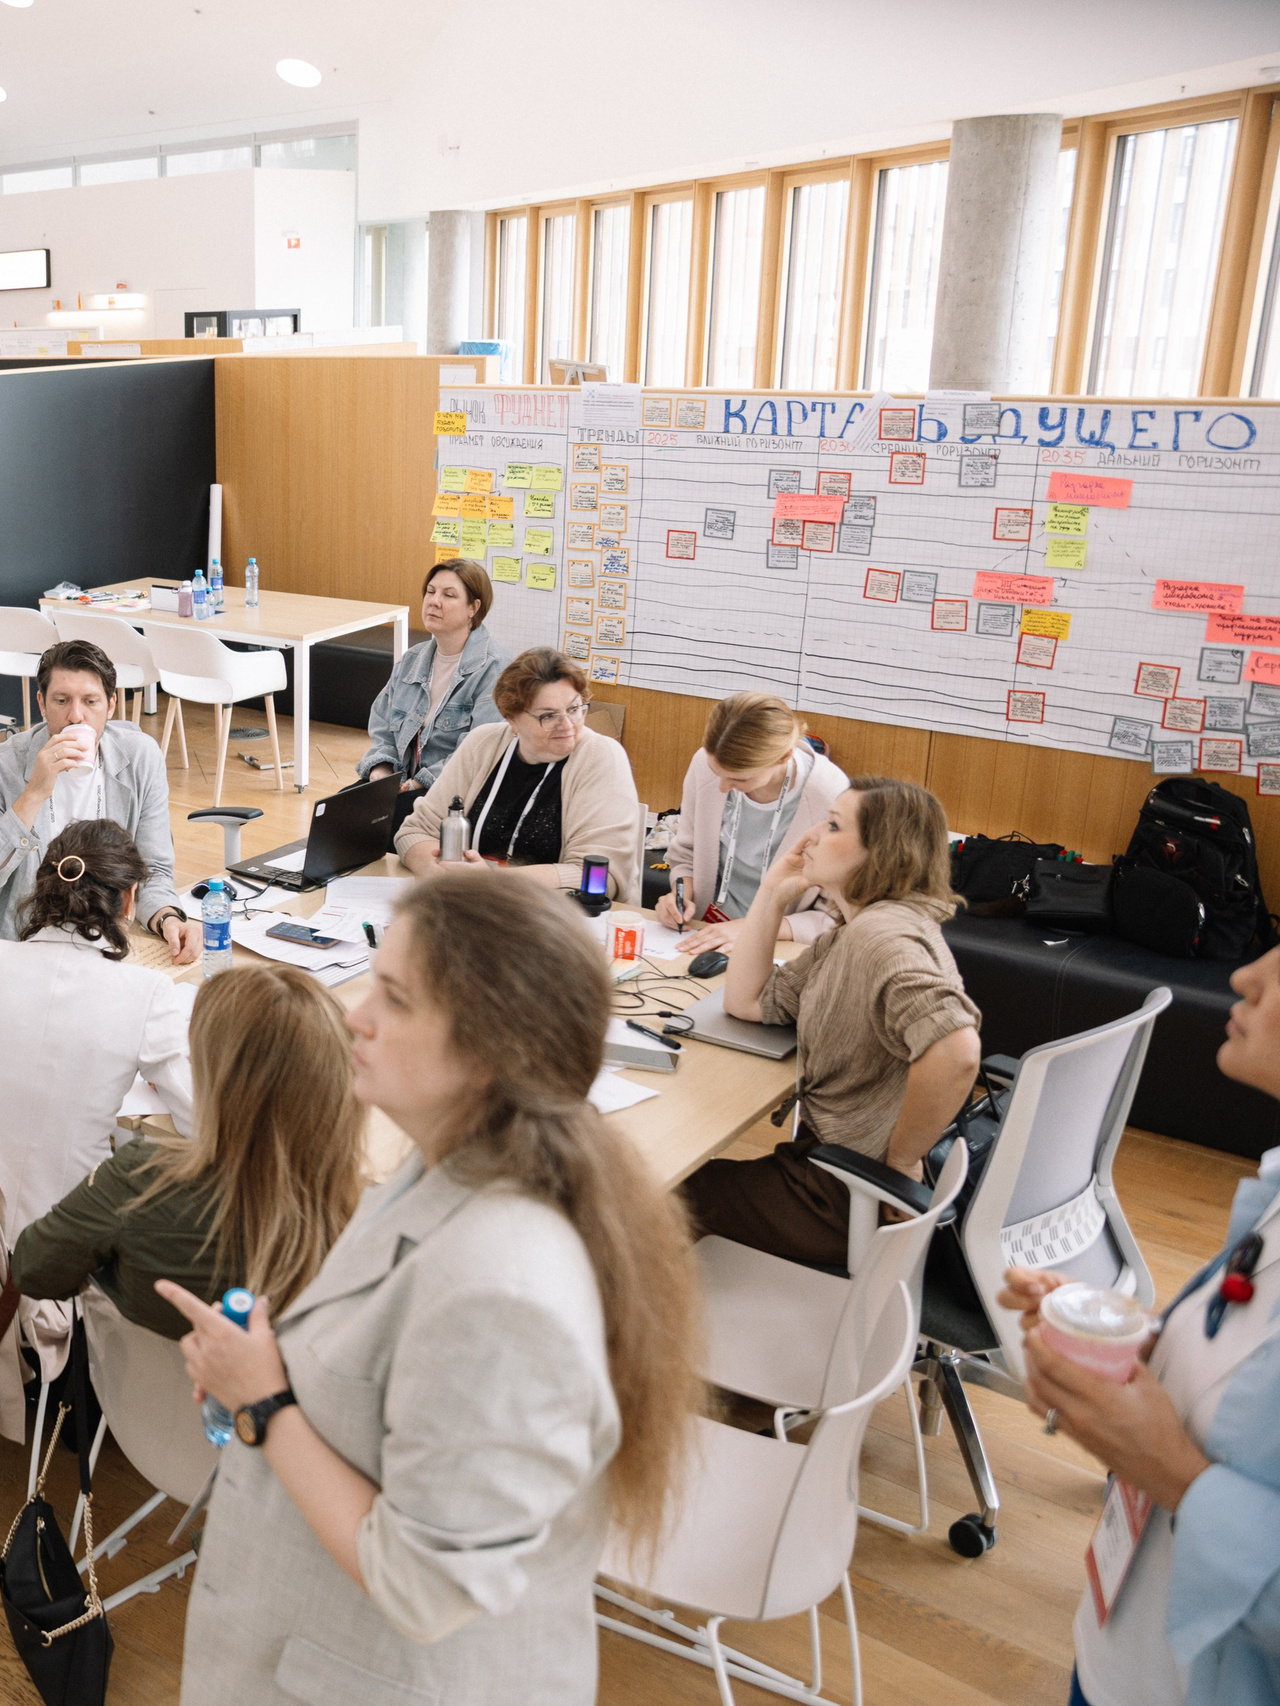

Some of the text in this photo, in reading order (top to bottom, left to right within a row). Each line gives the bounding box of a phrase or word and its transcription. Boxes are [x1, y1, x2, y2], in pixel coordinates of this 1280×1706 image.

[493, 394, 569, 428] ФУДНЕТ
[577, 428, 640, 445] ТРЕНДЫ
[916, 403, 1257, 455] БДУЩЕГО
[647, 432, 679, 446] 2025
[746, 437, 803, 451] ГОРИЗОНТ
[1041, 449, 1261, 472] 2035 ДАЛЬНИЙ ГОРИЗОНТ
